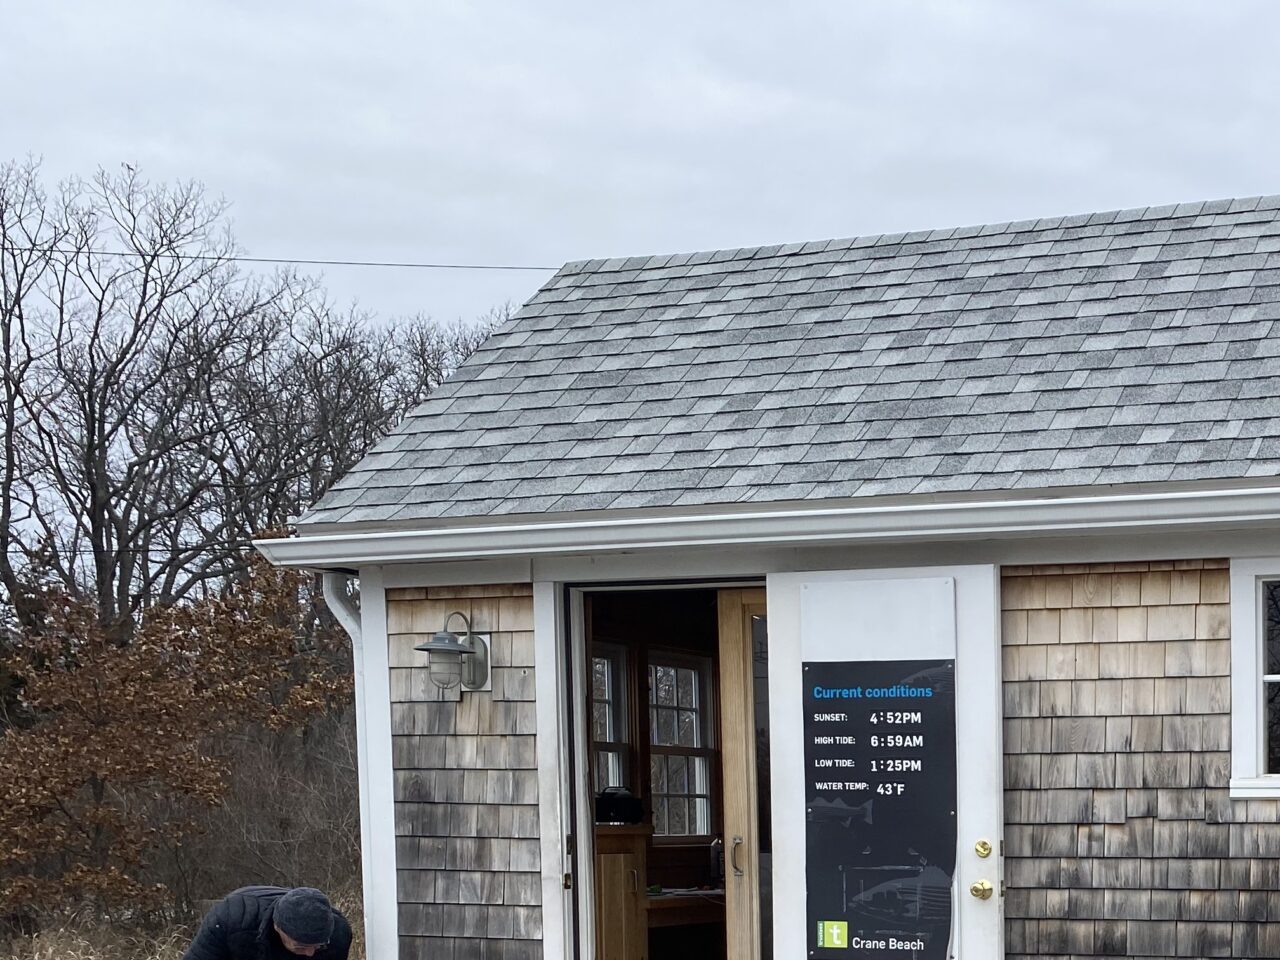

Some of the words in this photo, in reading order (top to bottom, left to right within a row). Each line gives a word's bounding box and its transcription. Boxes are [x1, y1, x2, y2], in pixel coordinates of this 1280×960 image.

[813, 686, 863, 698] Current
[865, 685, 933, 697] conditions
[814, 713, 848, 721] SUNSET:
[869, 712, 922, 724] 4:52PM
[814, 736, 834, 744] HIGH
[835, 736, 856, 744] TIDE:
[870, 735, 924, 747] 6:59AM
[815, 759, 833, 767] LOW
[870, 760, 922, 771] 1:25PM
[815, 782, 844, 790] WATER
[844, 782, 869, 790] TEMP:
[876, 783, 905, 795] 43°F
[852, 937, 886, 949] Crane
[888, 938, 924, 950] Beach
